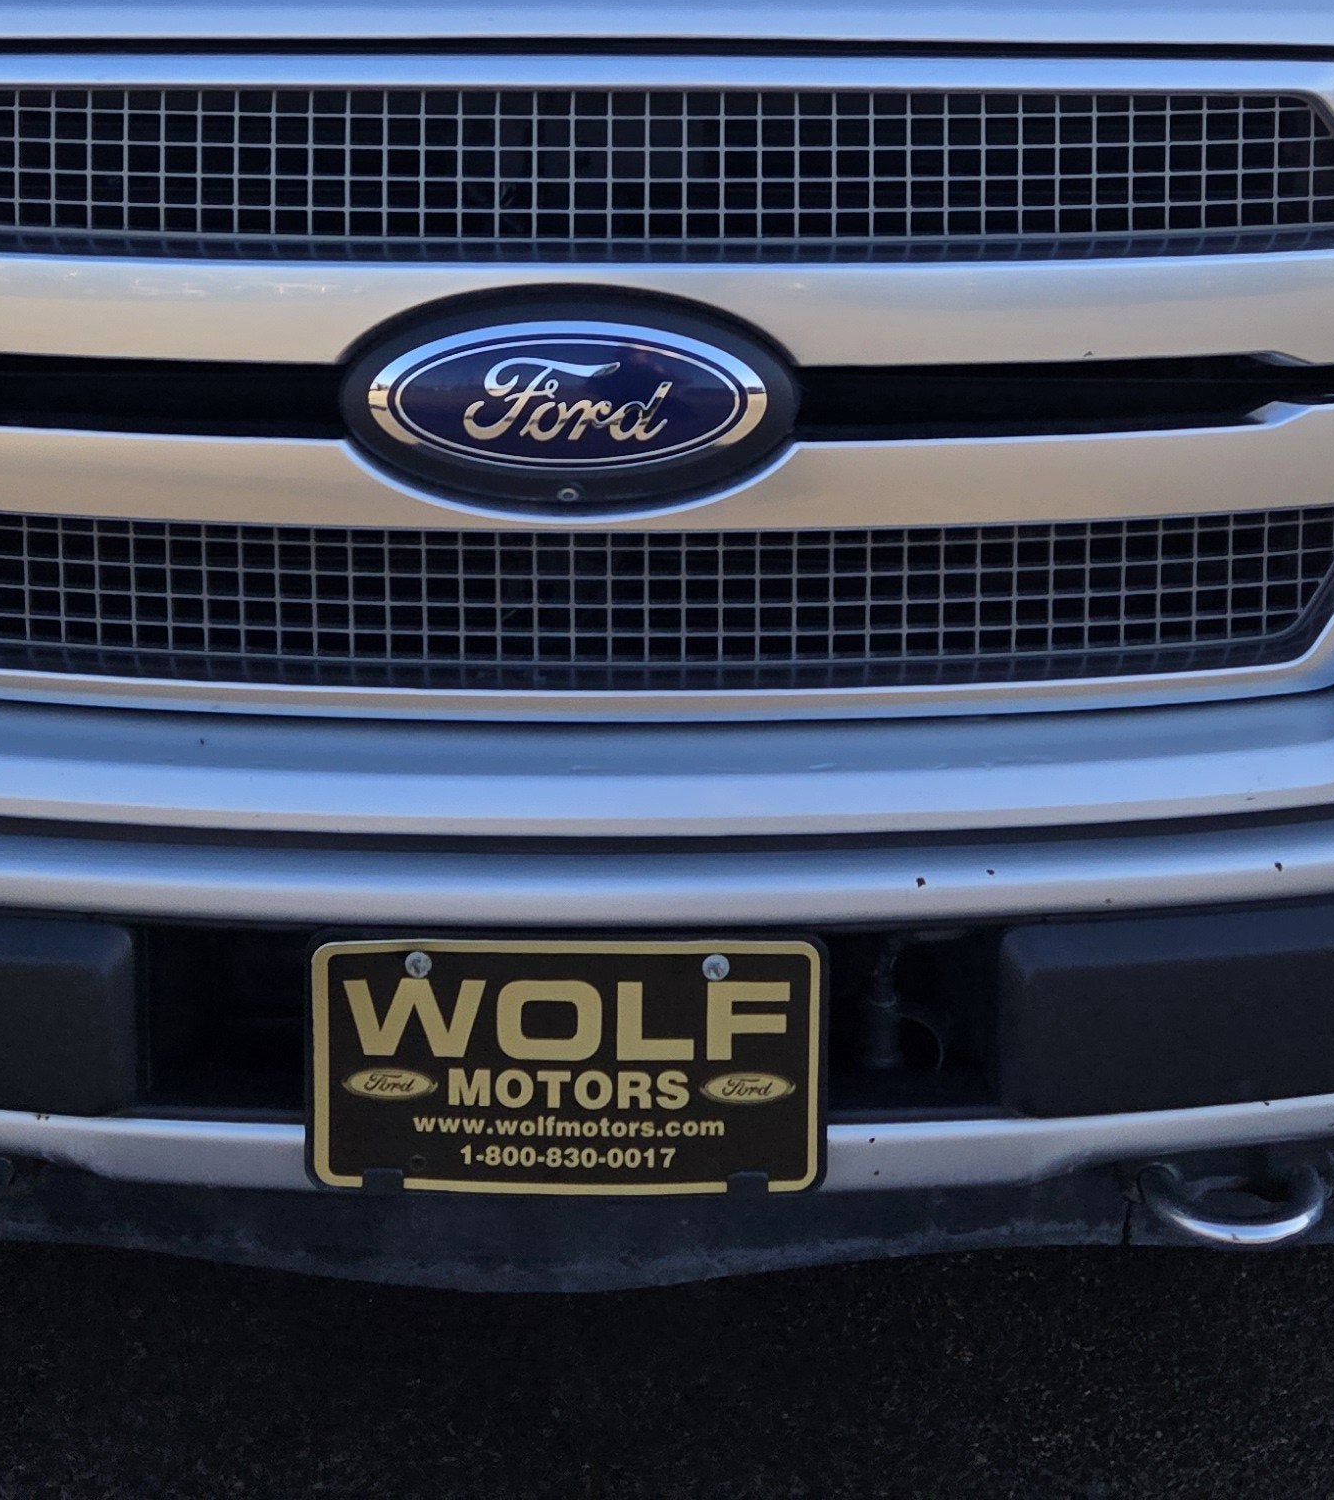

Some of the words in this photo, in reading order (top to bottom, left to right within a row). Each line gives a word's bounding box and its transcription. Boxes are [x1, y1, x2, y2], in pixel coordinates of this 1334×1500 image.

[463, 357, 672, 441] Ford
[343, 977, 791, 1062] WOLF
[363, 1072, 415, 1093] Ford
[447, 1067, 690, 1110] MOTORS
[722, 1078, 773, 1097] Ford
[412, 1114, 725, 1138] www.wolfmotors.com
[460, 1145, 677, 1169] 1-800-830-0017
